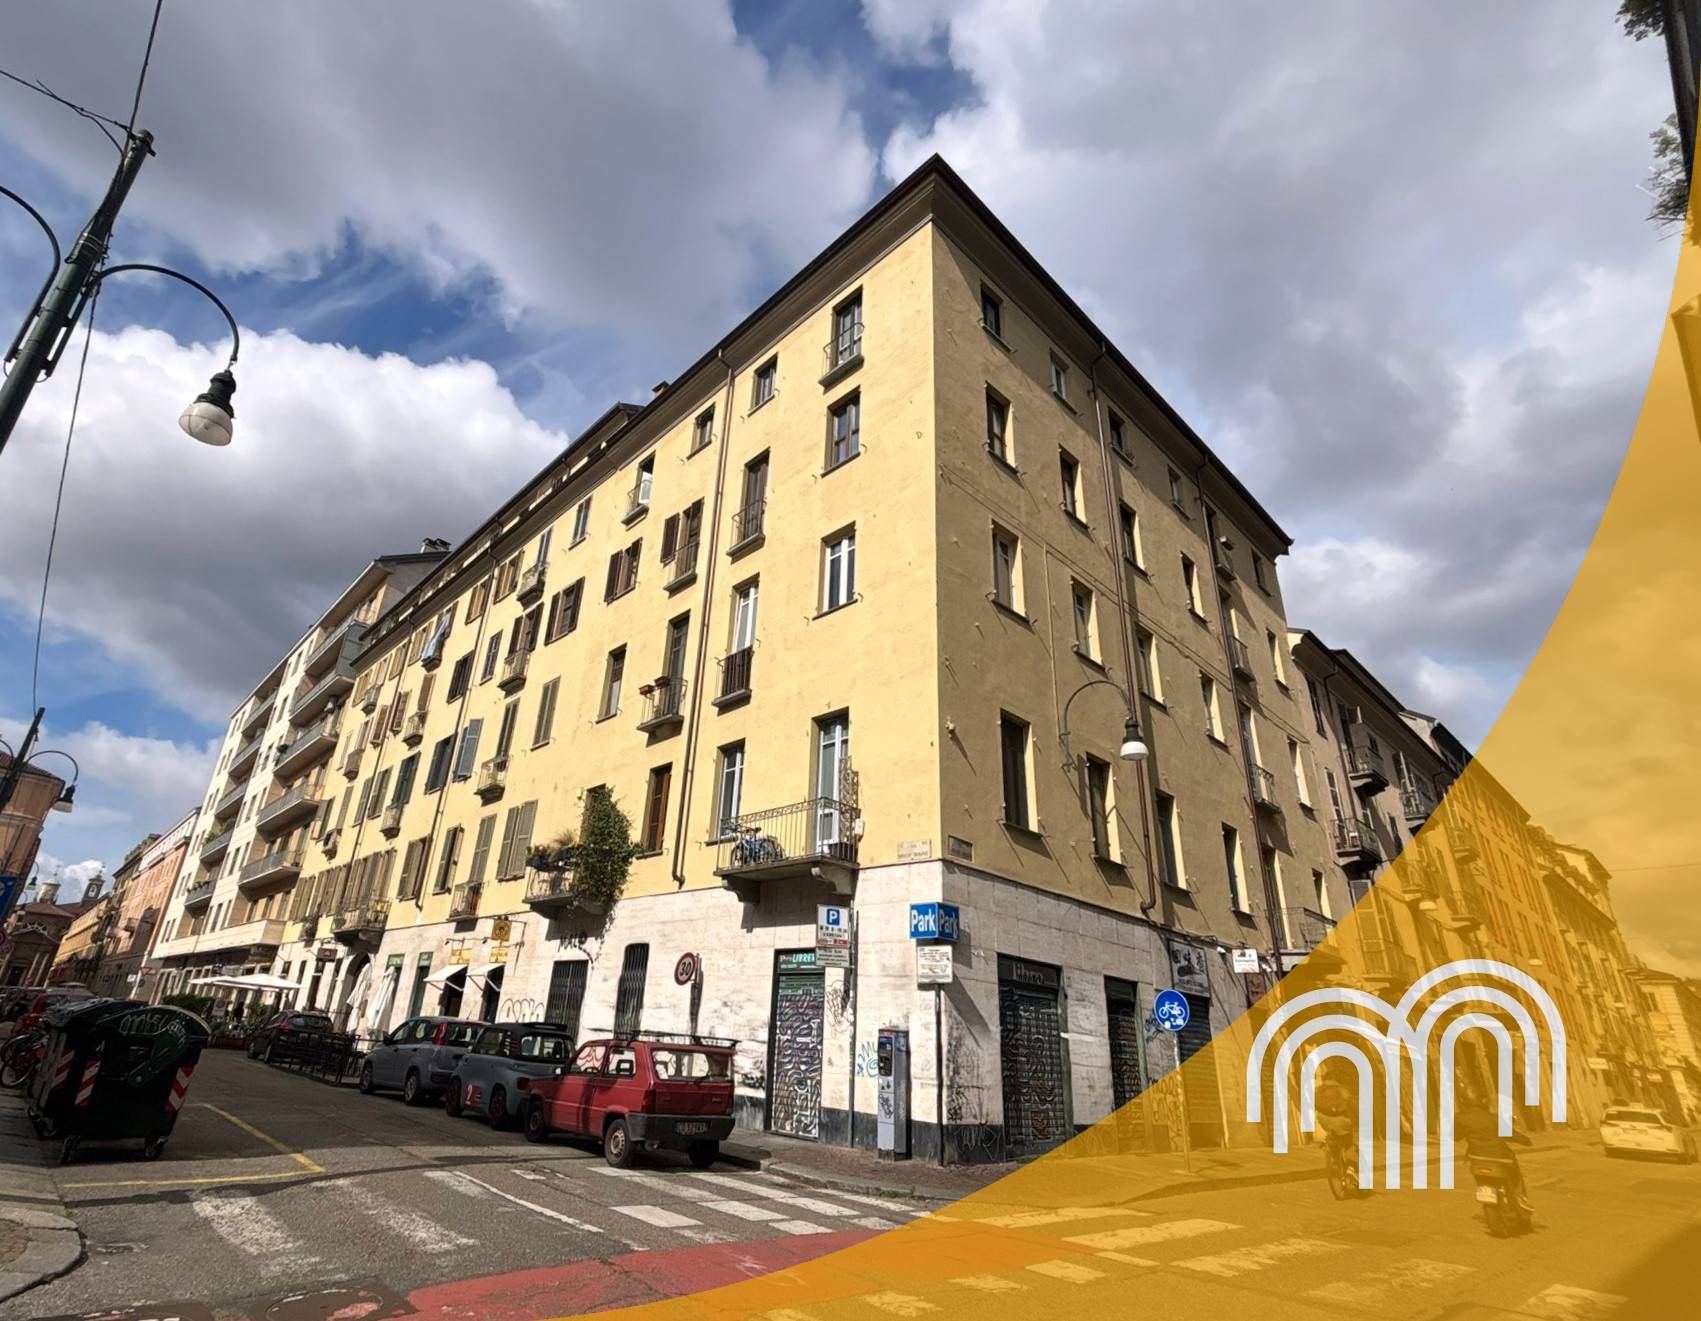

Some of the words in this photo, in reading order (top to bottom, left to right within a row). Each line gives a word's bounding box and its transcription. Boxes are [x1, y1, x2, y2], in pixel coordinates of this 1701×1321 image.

[829, 910, 838, 923] P
[911, 908, 936, 932] Park
[939, 908, 959, 939] Park
[680, 961, 691, 977] 30
